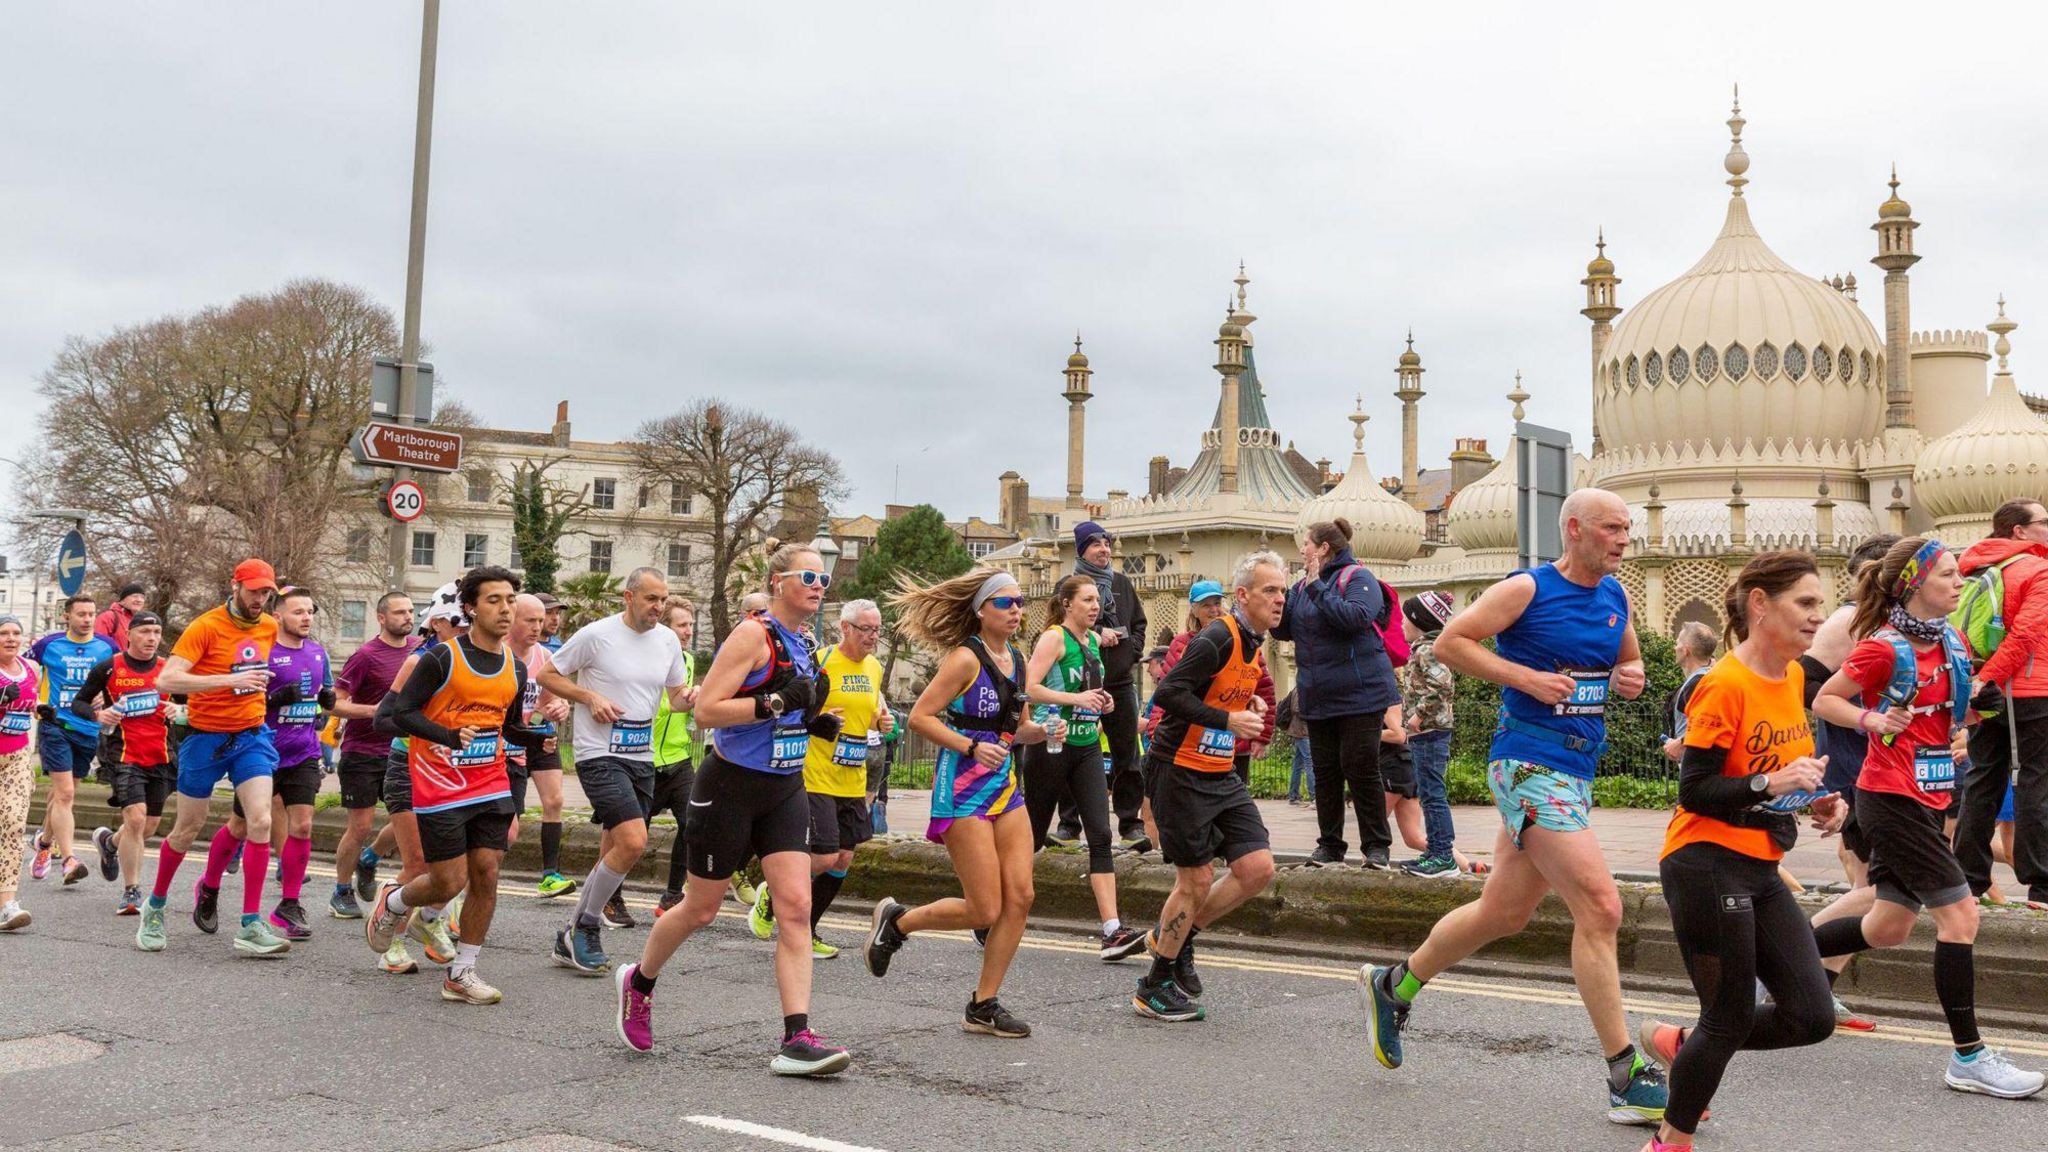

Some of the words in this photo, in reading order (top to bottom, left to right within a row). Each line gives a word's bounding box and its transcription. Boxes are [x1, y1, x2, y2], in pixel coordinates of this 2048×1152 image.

[384, 431, 457, 452] Marlborough
[398, 446, 440, 462] Theatre
[395, 493, 420, 509] 20
[115, 678, 145, 687] ROSS
[1577, 686, 1605, 701] 8703
[129, 697, 158, 710] 17981
[627, 733, 649, 745] 9026
[1919, 768, 1926, 777] C
[1611, 1094, 1628, 1107] HOKA
